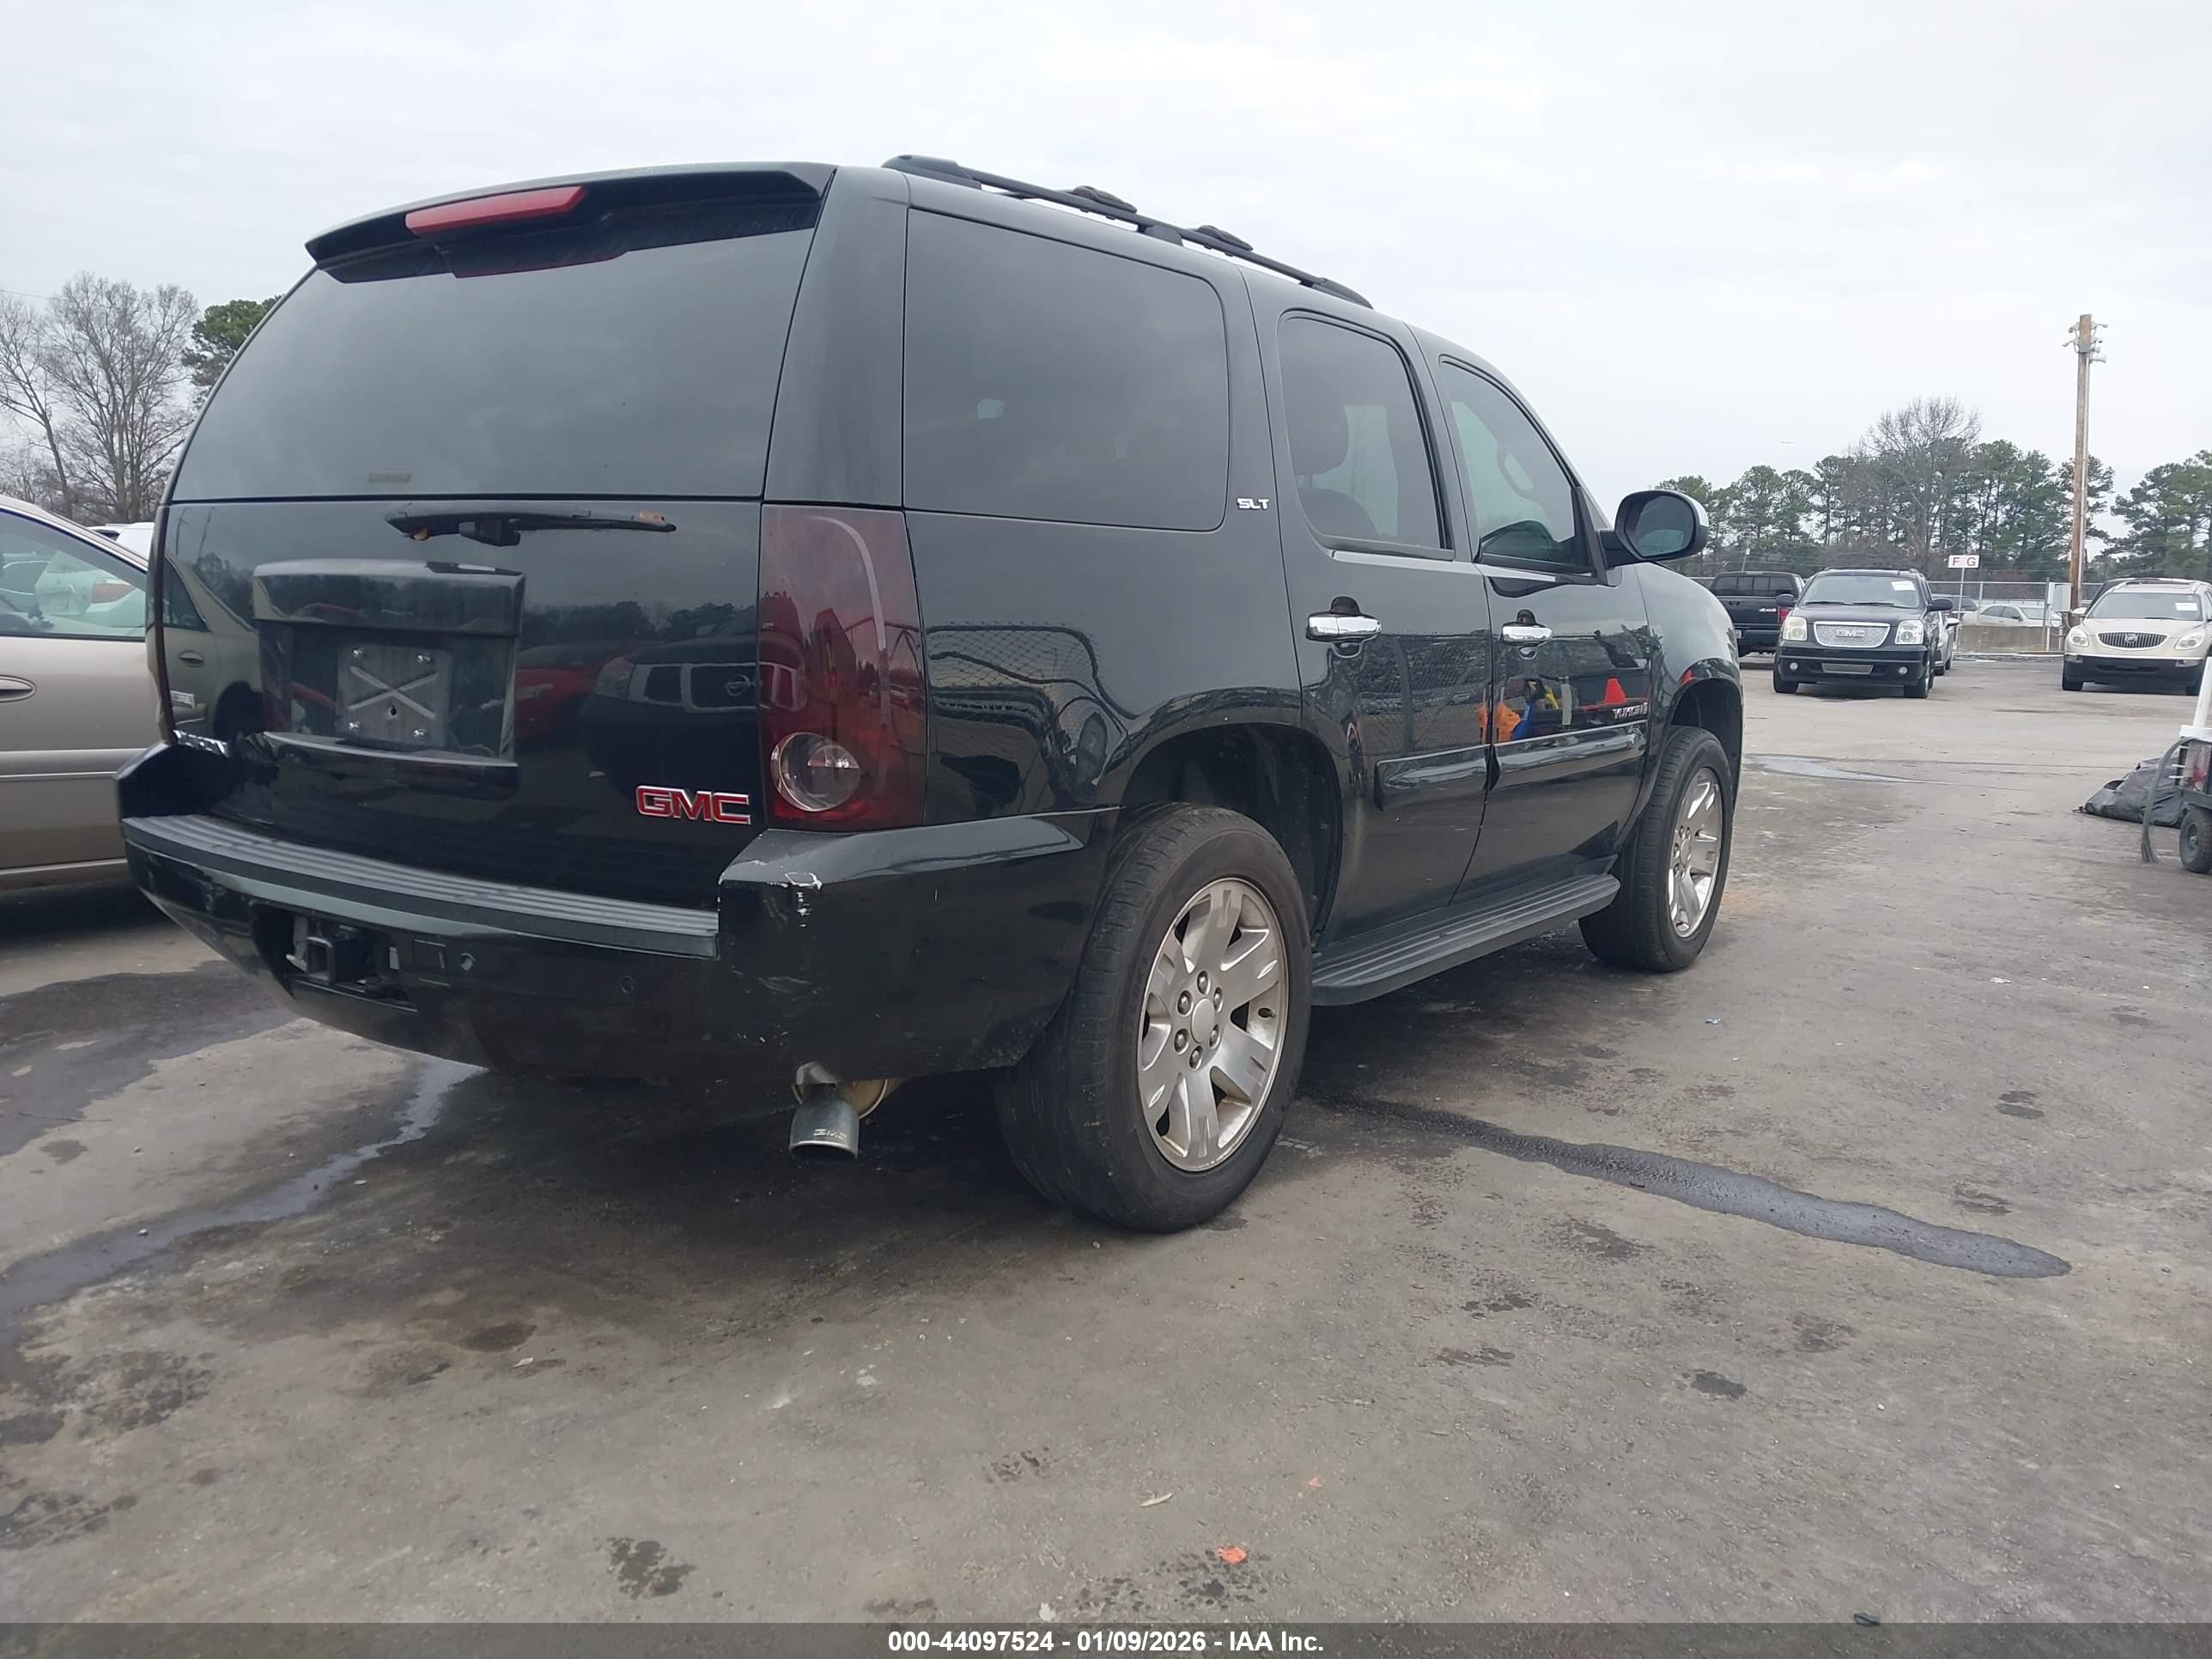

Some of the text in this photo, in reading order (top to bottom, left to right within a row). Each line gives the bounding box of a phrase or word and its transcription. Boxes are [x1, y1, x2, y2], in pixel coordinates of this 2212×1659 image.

[1237, 498, 1269, 510] SLT
[1952, 556, 1977, 567] F G
[635, 785, 751, 825] GMC
